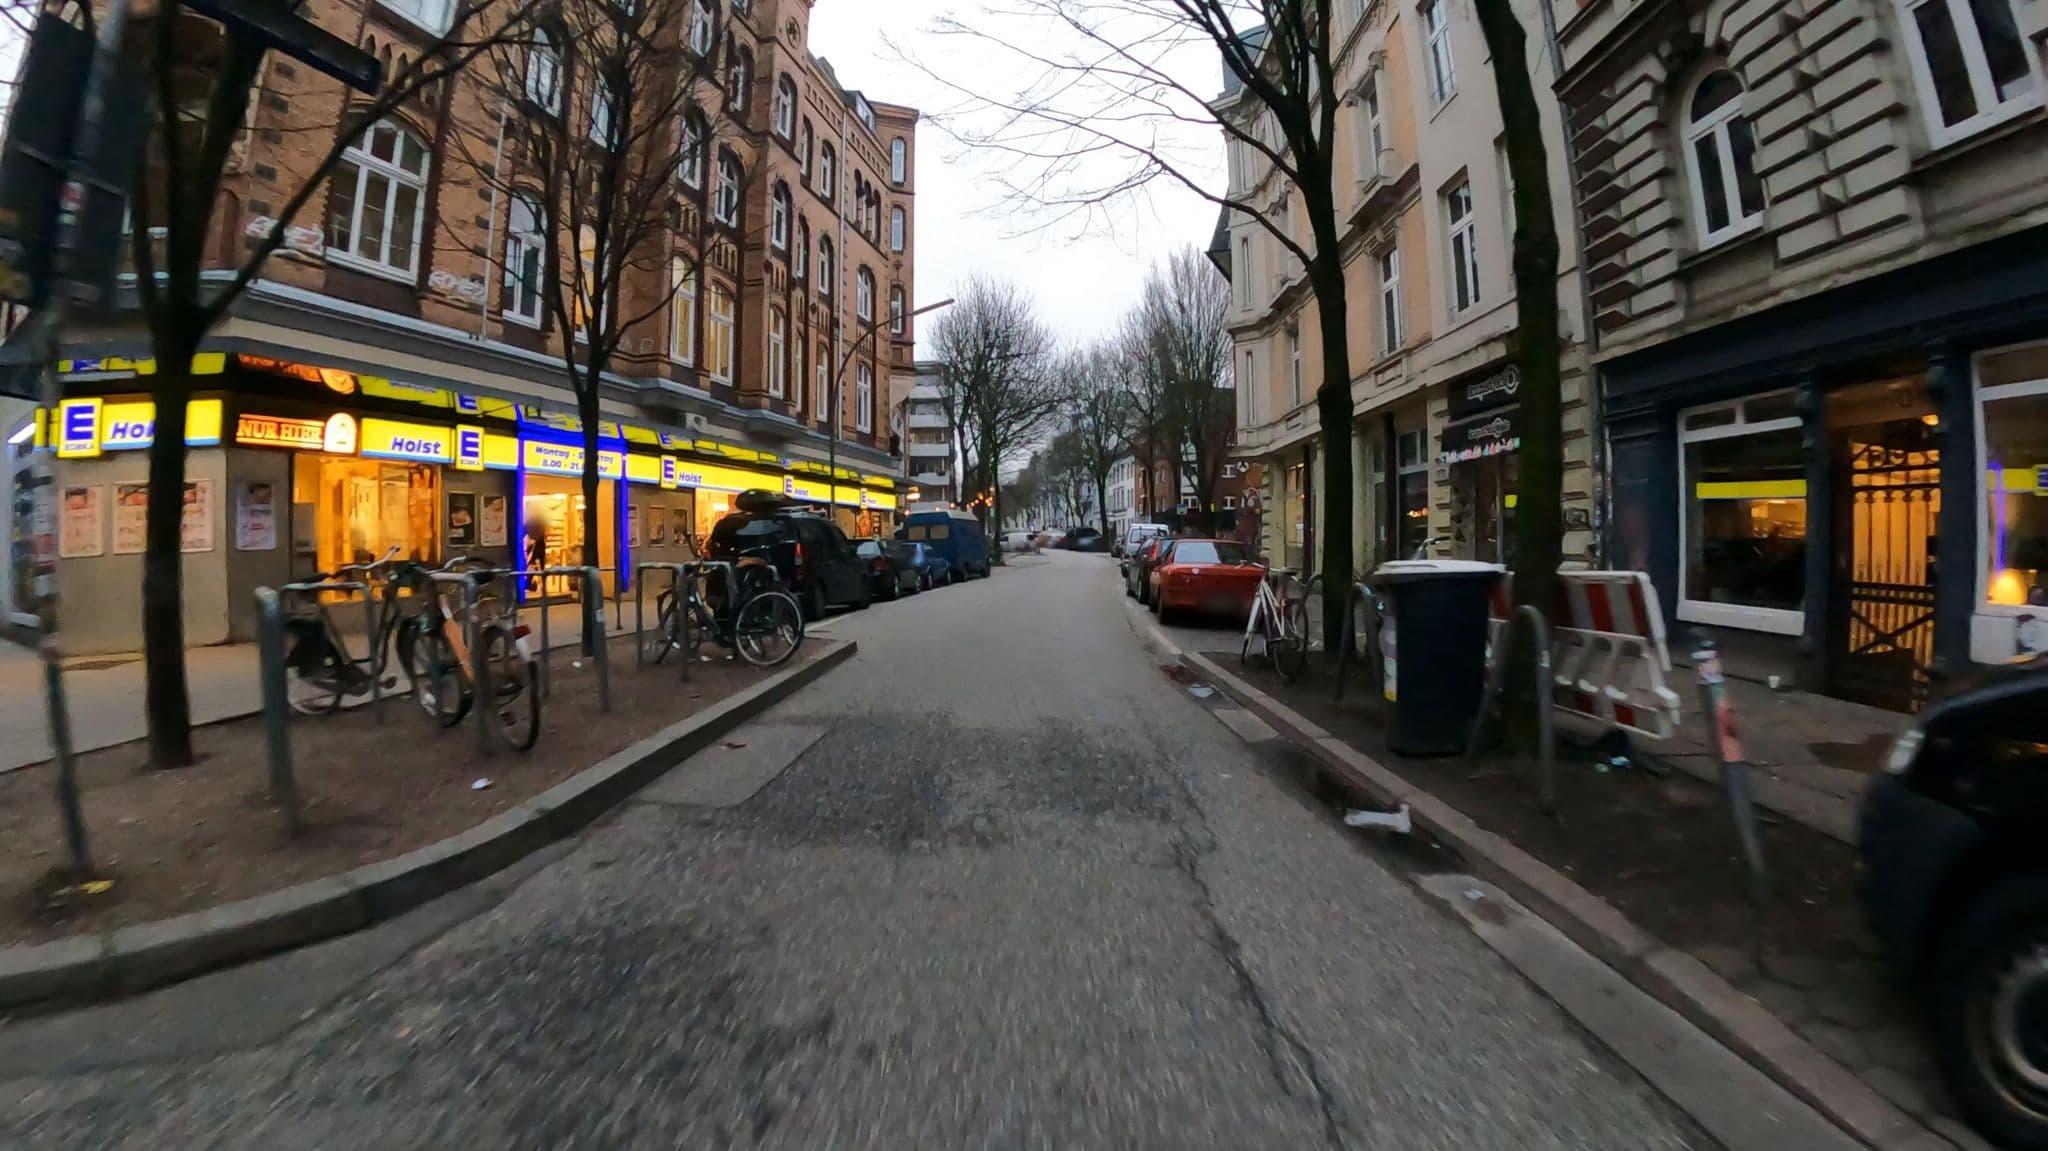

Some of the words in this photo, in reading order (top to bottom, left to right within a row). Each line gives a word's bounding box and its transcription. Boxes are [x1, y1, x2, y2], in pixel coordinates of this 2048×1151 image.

[65, 405, 95, 441] E
[110, 419, 156, 440] Hol
[236, 419, 279, 439] NUR
[280, 423, 321, 443] HIER
[391, 436, 441, 455] Holst
[460, 429, 480, 458] E
[535, 446, 570, 459] Montag
[663, 459, 675, 480] E
